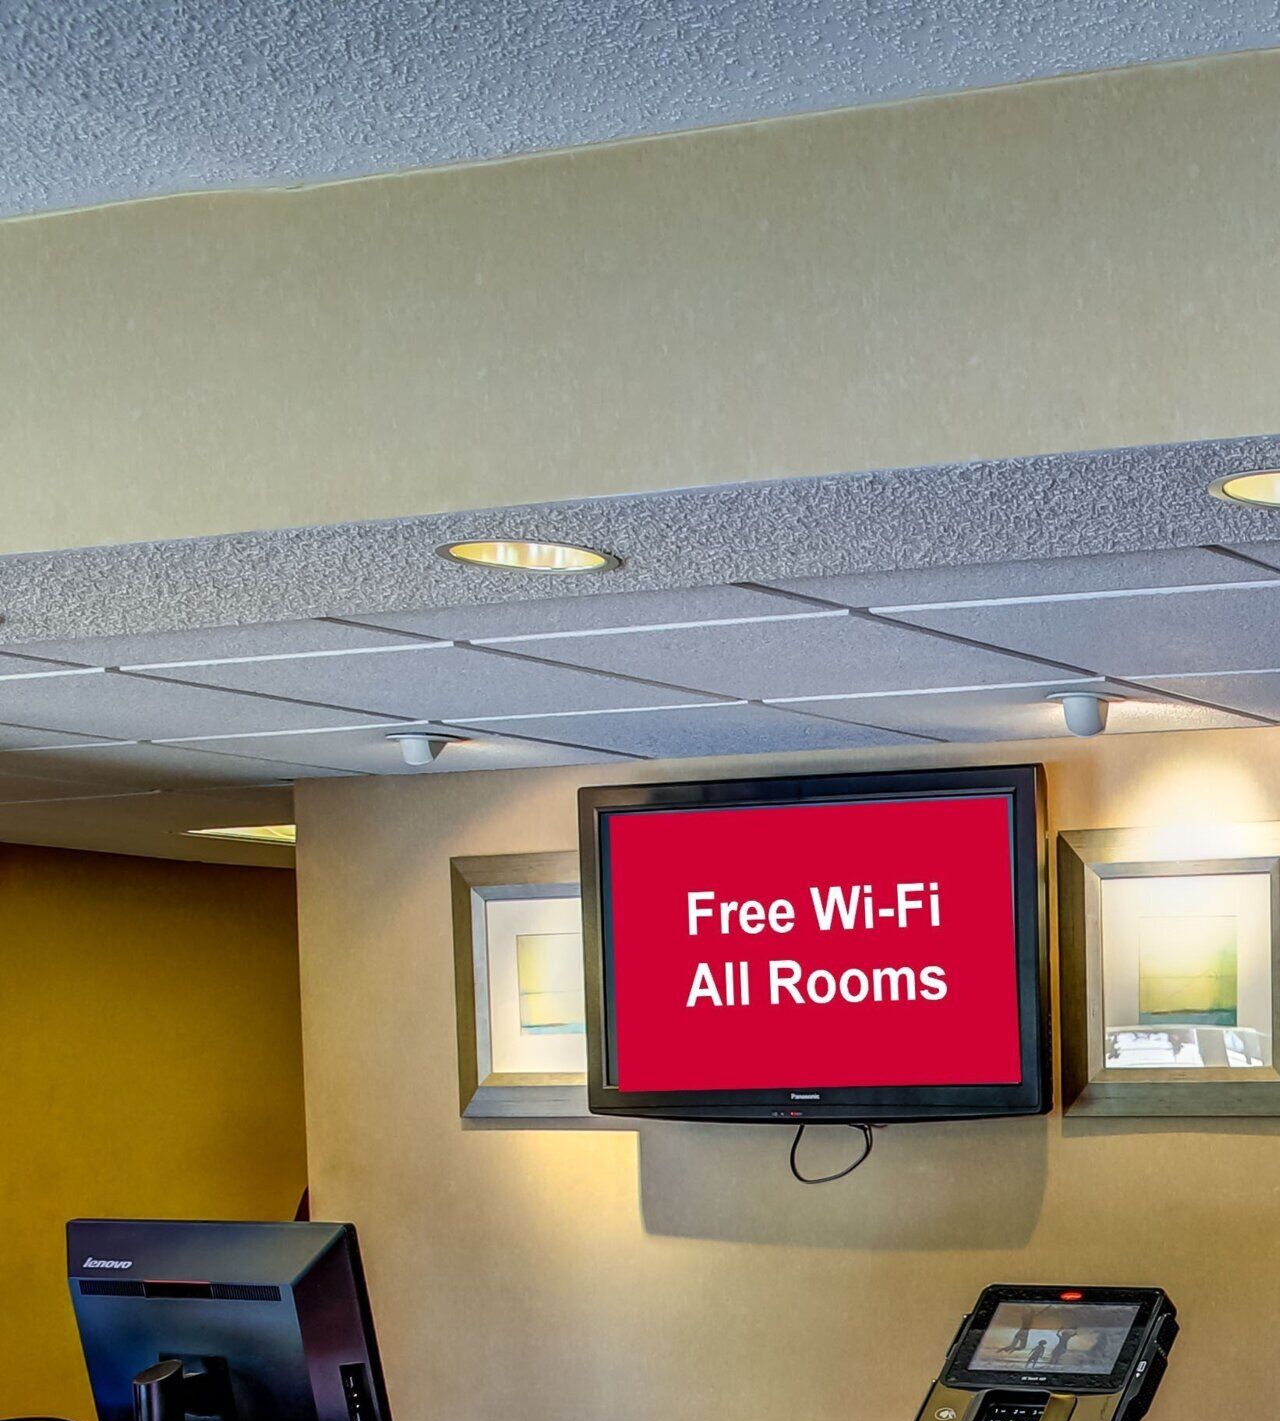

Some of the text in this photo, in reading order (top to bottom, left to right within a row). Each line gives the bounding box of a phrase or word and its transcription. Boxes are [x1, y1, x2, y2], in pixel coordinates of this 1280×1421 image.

[687, 881, 942, 937] Free Wi-Fi
[686, 958, 949, 1009] All Rooms
[82, 1256, 133, 1270] lenovo
